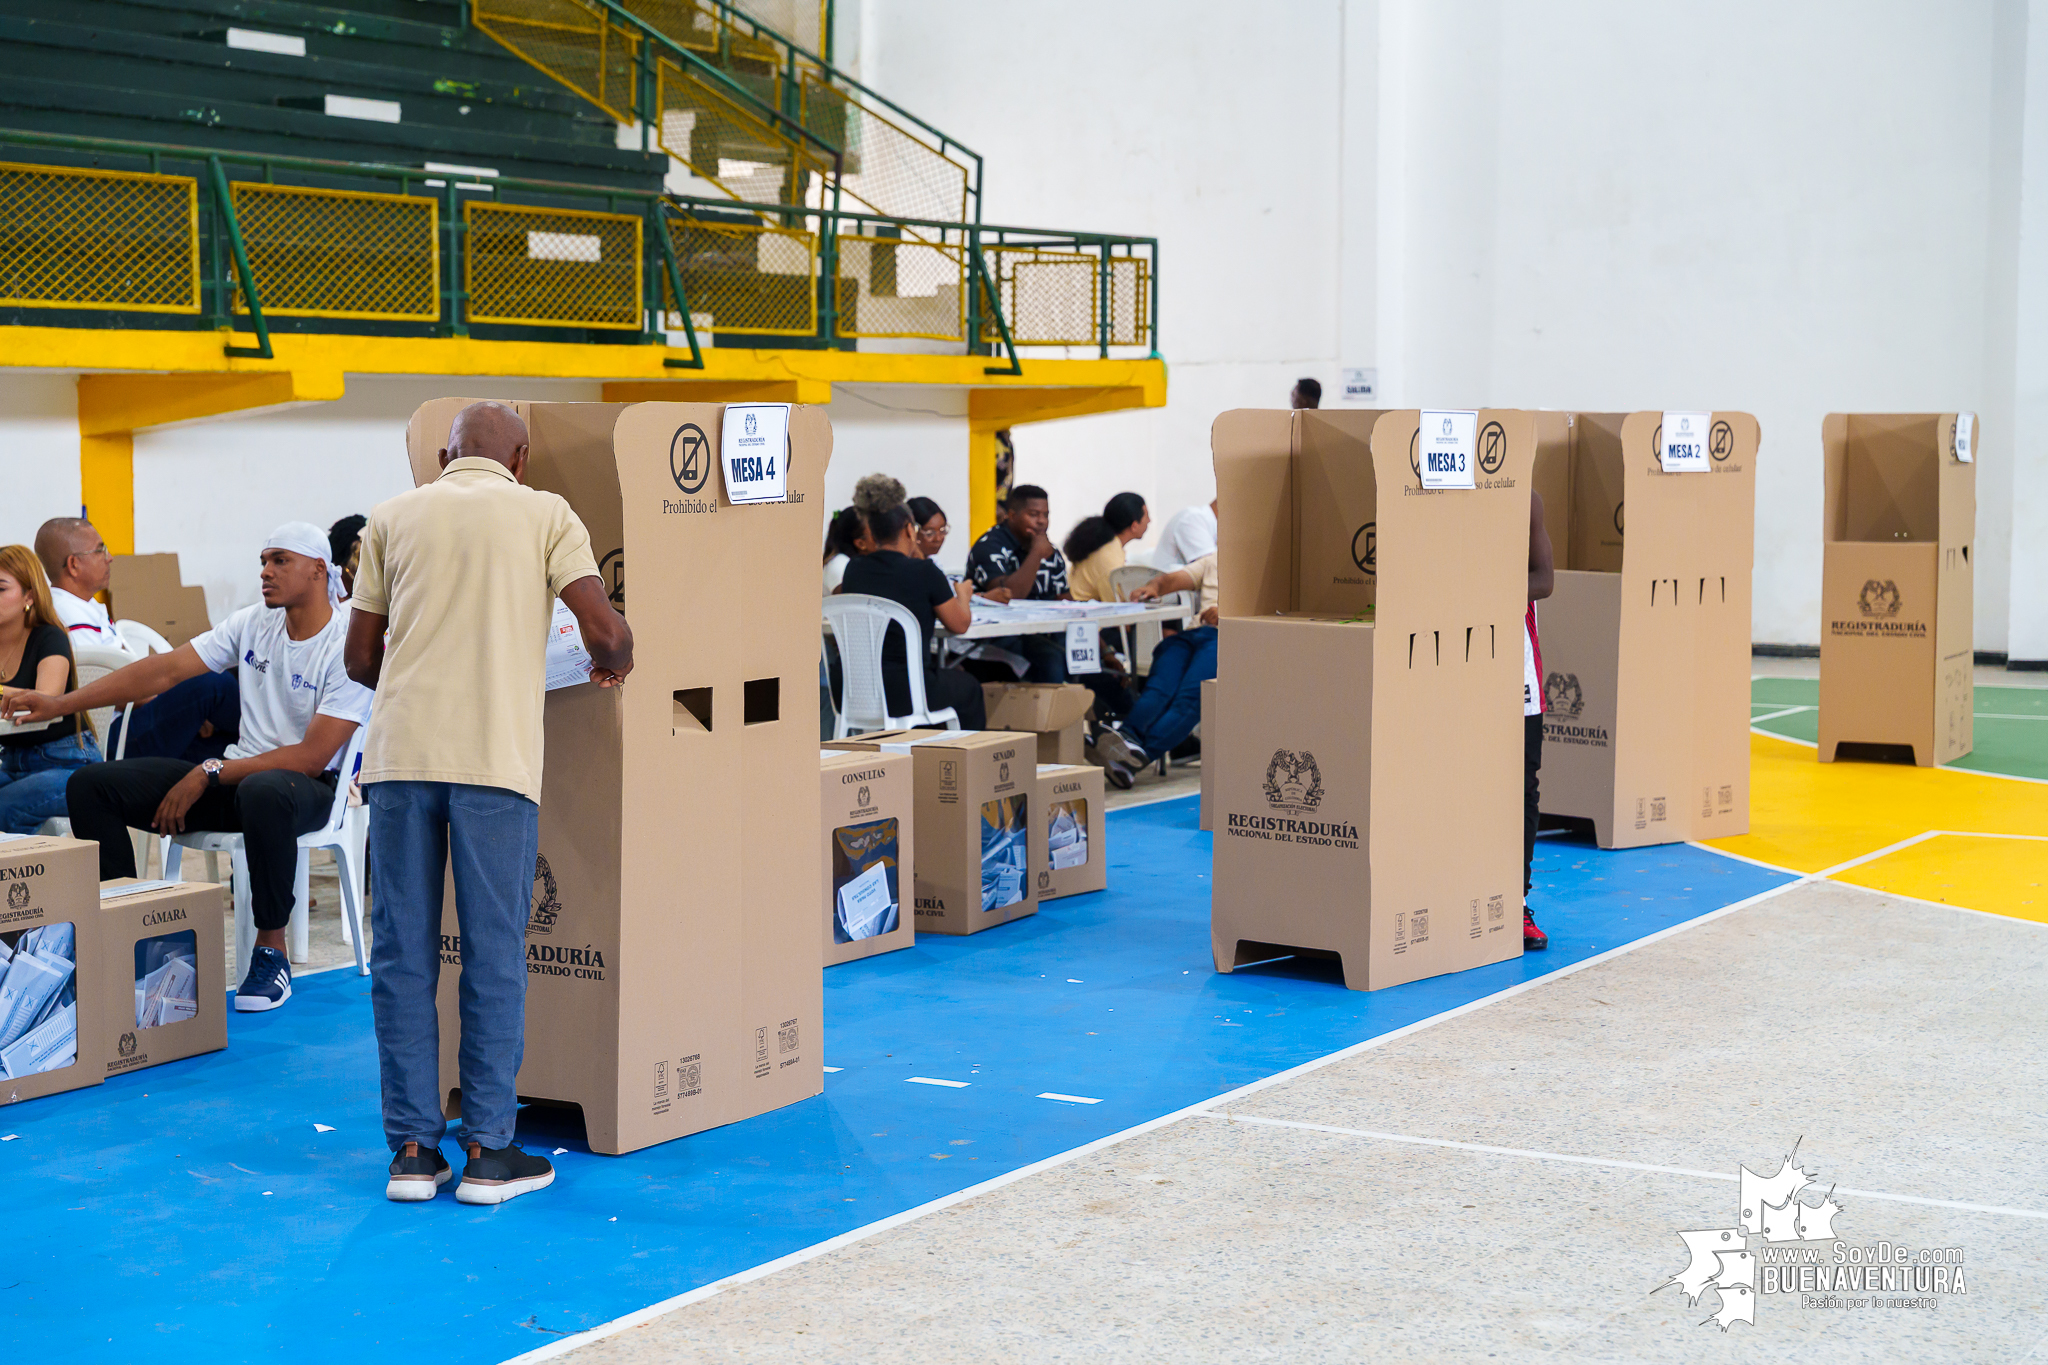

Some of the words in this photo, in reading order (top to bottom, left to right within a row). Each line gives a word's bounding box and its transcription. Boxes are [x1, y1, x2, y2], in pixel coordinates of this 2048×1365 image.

[1668, 444, 1693, 458] MESA
[1695, 444, 1701, 458] 2
[731, 457, 763, 482] MESA
[766, 456, 775, 480] 4
[1428, 453, 1456, 472] MESA
[1459, 453, 1465, 472] 3
[1484, 479, 1493, 489] de
[1493, 477, 1516, 489] celular
[662, 500, 707, 514] Prohibido
[709, 499, 717, 513] el
[1333, 576, 1364, 585] Prohibido
[1831, 620, 1927, 631] REGISTRADURÍA
[1071, 649, 1088, 661] MESA
[1089, 648, 1094, 661] 2
[1542, 723, 1608, 740] STRADURÍA
[1548, 735, 1561, 743] DEL
[1563, 737, 1589, 746] ESTADO
[1590, 739, 1608, 748] CIVIL
[993, 749, 1015, 762] SENADO
[842, 768, 886, 785] CONSULTAS
[1053, 782, 1082, 795] CÁMARA
[1228, 813, 1359, 839] REGISTRADURÍA
[1227, 828, 1272, 840] NACIONAL
[1275, 833, 1293, 842] DEL
[1296, 835, 1332, 847] ESTADO
[1334, 839, 1359, 849] CIVIL
[0, 863, 45, 881] ENADO
[0, 906, 44, 920] EGISTRADURÍA
[142, 908, 188, 927] CÁMARA
[926, 908, 946, 918] CIVIL
[527, 963, 571, 978] ESTADO
[574, 968, 606, 981] CIVIL
[107, 1053, 148, 1068] REGISTRADURÍA
